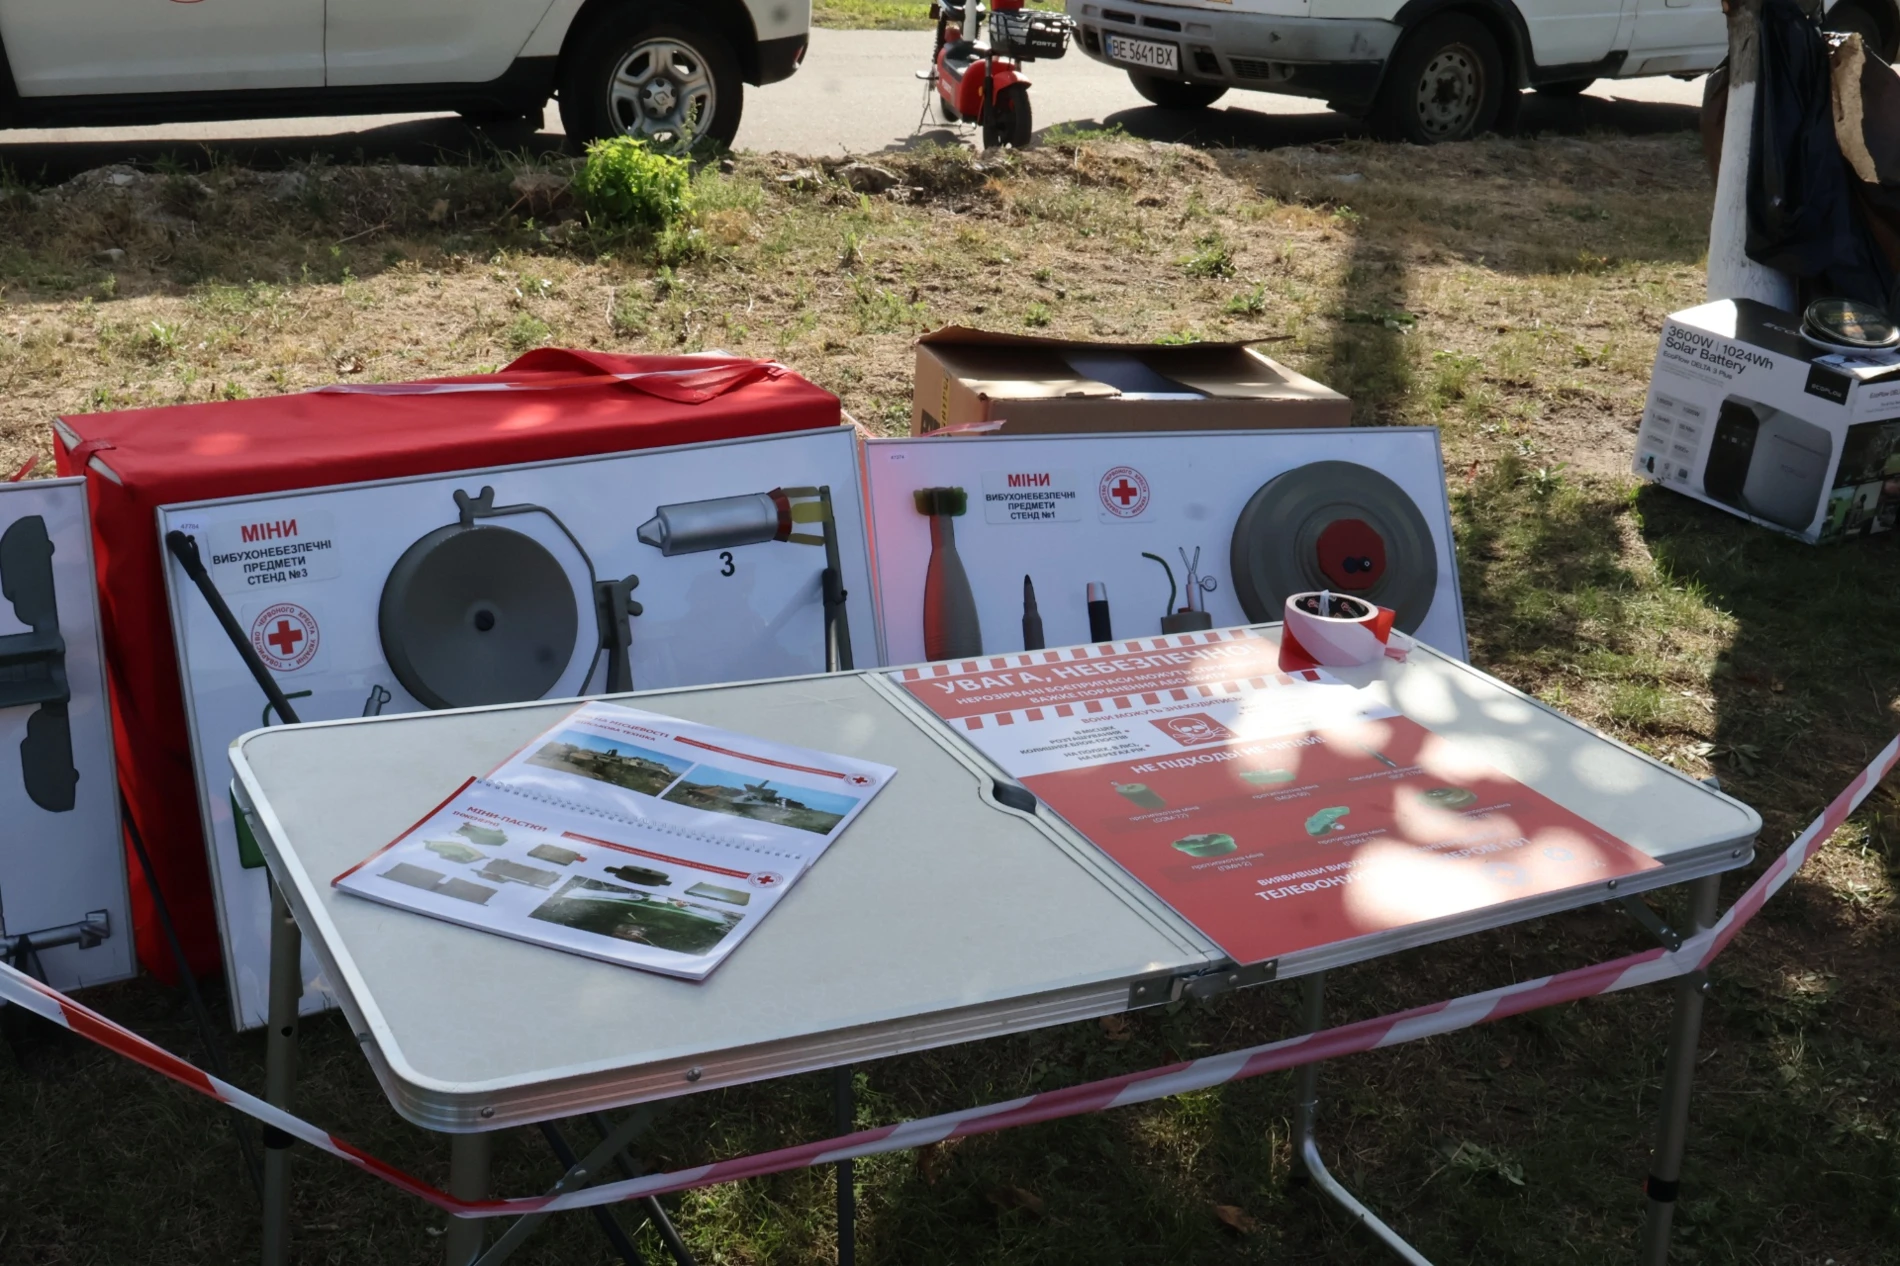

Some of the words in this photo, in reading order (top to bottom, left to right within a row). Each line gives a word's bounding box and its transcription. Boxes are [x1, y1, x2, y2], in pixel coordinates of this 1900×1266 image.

[1031, 40, 1057, 48] FORTE
[1112, 39, 1127, 59] BE
[1129, 42, 1154, 63] 5641
[1156, 46, 1173, 66] BX
[1665, 337, 1697, 356] Solar
[1700, 349, 1747, 374] Battery
[1667, 325, 1714, 349] 3600W
[1723, 344, 1774, 371] 1024Wh
[1662, 351, 1690, 366] EcoFlow
[1690, 360, 1711, 373] DELTA
[1713, 367, 1718, 375] 3
[1718, 369, 1733, 380] Plus
[1007, 473, 1051, 488] МІНИ
[986, 491, 1076, 502] ВИБУХОНЕБЕЗПЕЧНІ
[1008, 501, 1056, 511] ПРЕДМЕТИ
[1010, 511, 1040, 520] СТЕНД
[1041, 511, 1056, 519] №1
[240, 519, 298, 543] МІНИ
[212, 539, 332, 565] ВИБУХОНЕБЕЗПЕЧНІ
[243, 556, 307, 573] ПРЕДМЕТИ
[719, 551, 736, 577] 3
[247, 572, 286, 585] СТЕНД
[288, 568, 308, 580] №3
[257, 606, 295, 628] ЧЕРВОНОГО
[298, 611, 316, 635] ХРЕСТА
[254, 631, 283, 668] ТОВАРИСТВО
[295, 639, 316, 666] УКРАЇНИ
[933, 671, 1052, 694] УВАГА,
[1050, 643, 1260, 679] НЕБЕЗПЕЧНО!
[956, 688, 1043, 705] НЕРОЗІРВАНІ
[1044, 674, 1135, 693] БОЄПРИПАСИ
[1134, 669, 1191, 682] МОЖУТЬ
[1029, 692, 1078, 704] ВАЖКЕ
[1078, 682, 1157, 698] ПОРАНЕННЯ
[1160, 677, 1186, 687] АБО
[1080, 714, 1114, 724] ВОНИ
[1114, 708, 1163, 719] МОЖУТЬ
[609, 720, 669, 738] МІСЦЕВОСТІ
[622, 730, 656, 741] ТЕХНІКА
[1049, 730, 1122, 744] РОЗТАШУВАННЯ
[1081, 725, 1116, 734] МІСЦЯХ
[1069, 735, 1128, 747] БЛОК-ПОСТІВ
[1092, 750, 1131, 759] БЕРЕГАХ
[1130, 763, 1159, 774] НЕ
[1242, 744, 1266, 756] НЕ
[1252, 787, 1301, 799] протипіхотна
[466, 806, 548, 832] МІНИ-ПАСТКИ
[1129, 809, 1181, 821] протипіхотна
[1317, 832, 1369, 844] протипіхотна
[1191, 855, 1245, 870] протипіхотна
[1255, 868, 1372, 901] ТЕЛЕФОНУЙ
[1257, 866, 1327, 886] ВИЯВИВШИ
